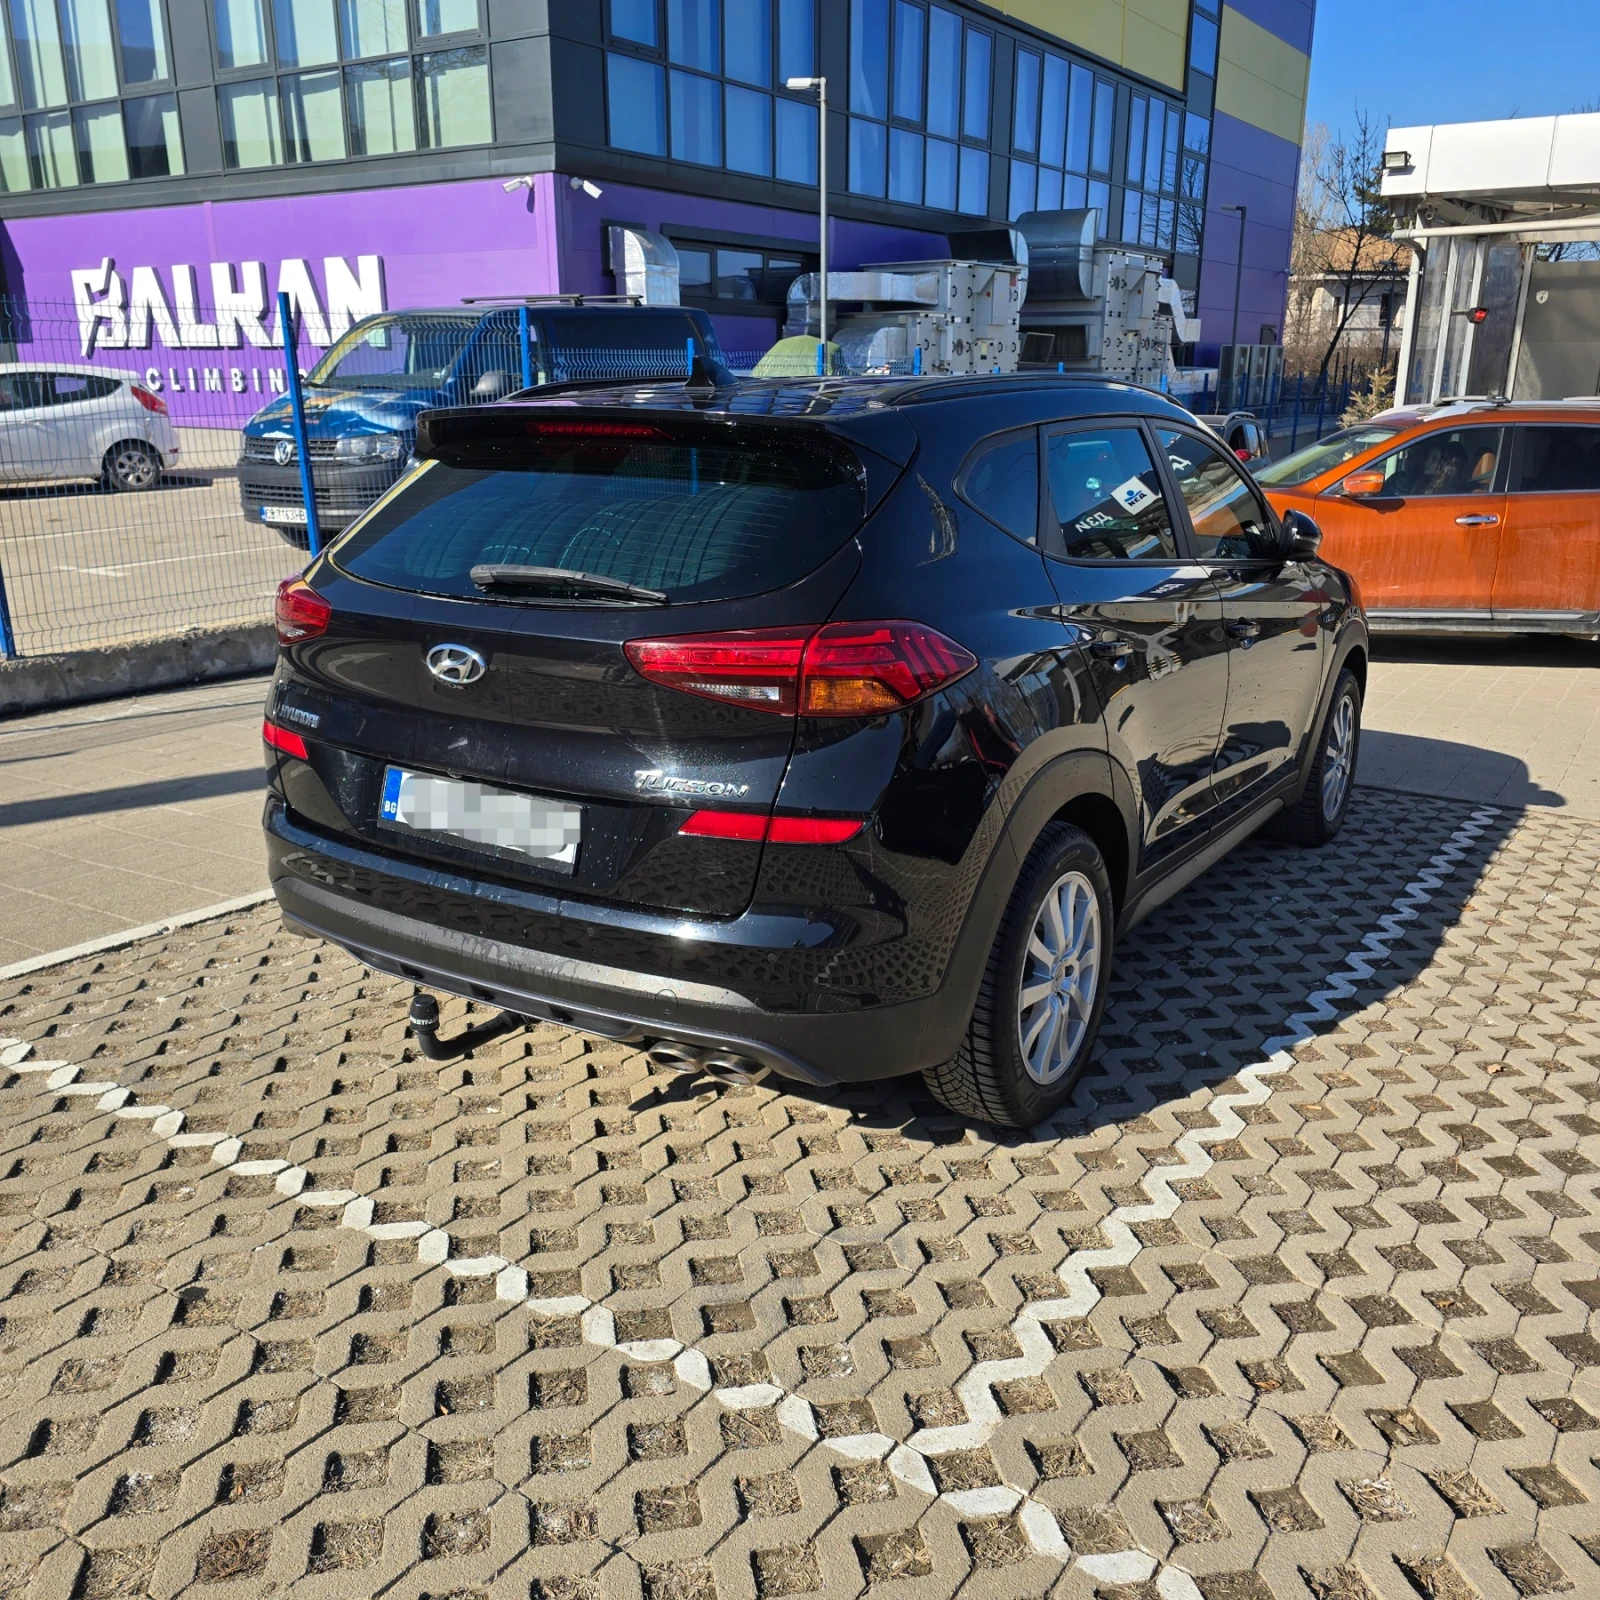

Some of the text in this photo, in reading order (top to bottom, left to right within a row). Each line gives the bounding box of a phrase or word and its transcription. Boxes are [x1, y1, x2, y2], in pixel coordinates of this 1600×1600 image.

[71, 254, 390, 360] BALKAN
[634, 769, 749, 798] TUCSON
[384, 800, 397, 814] BG
